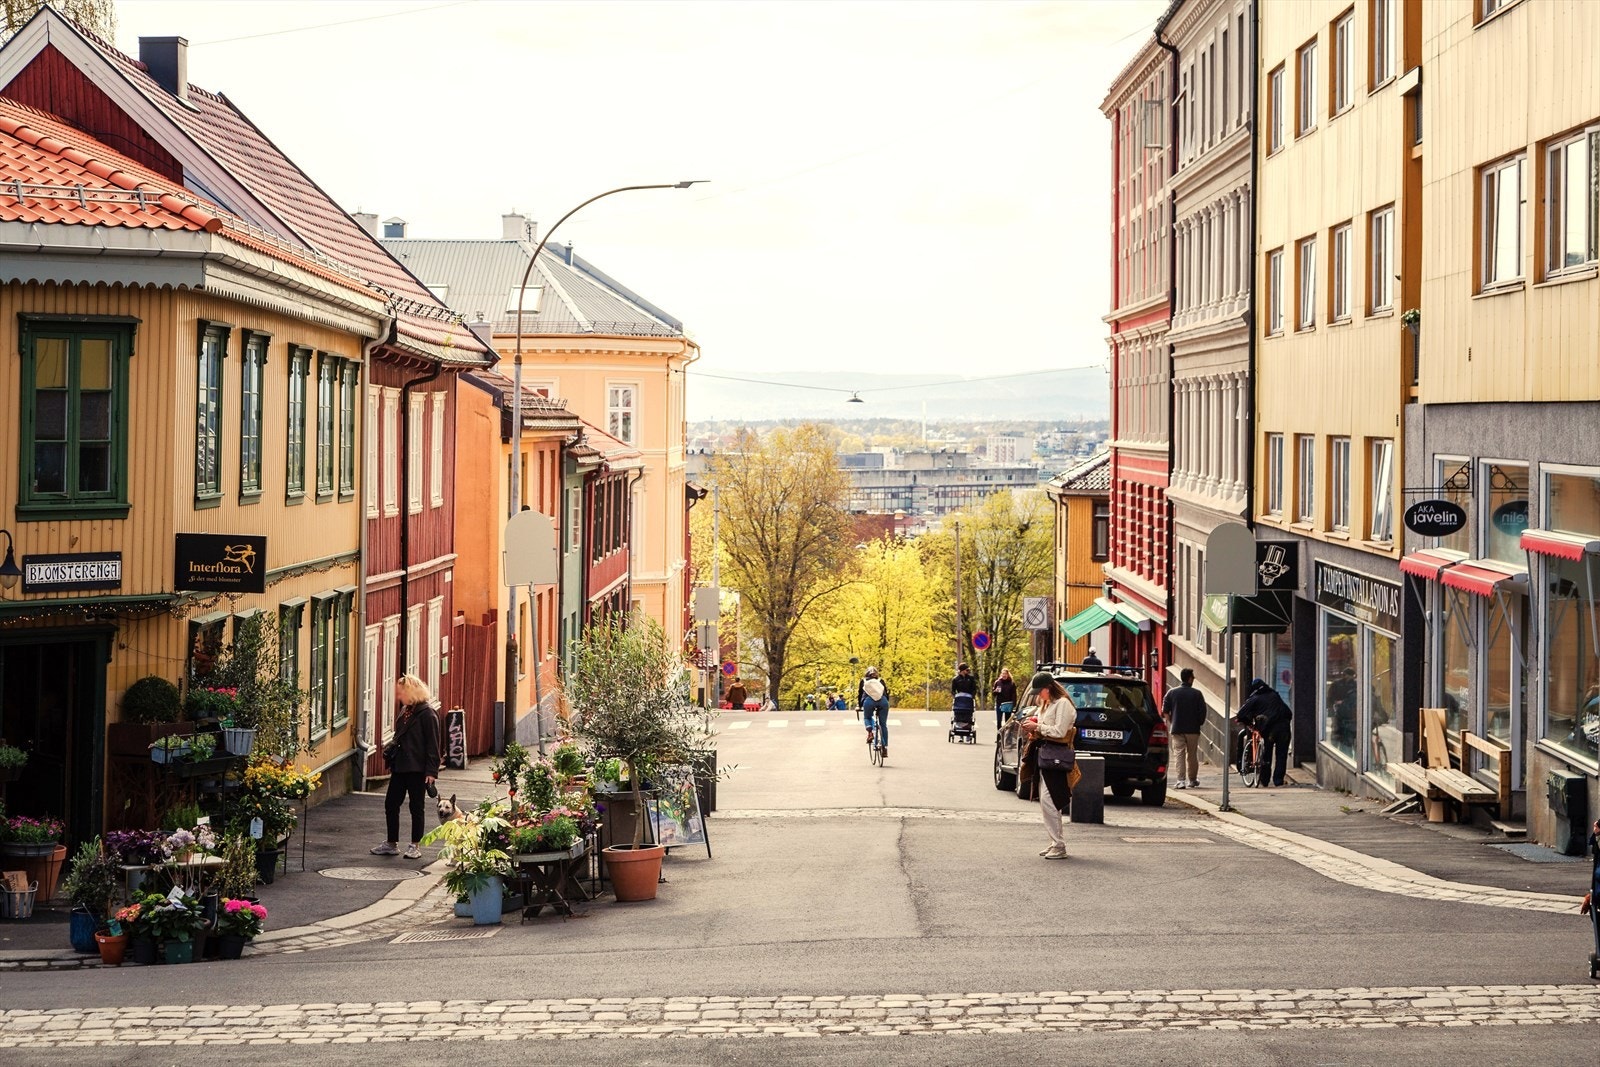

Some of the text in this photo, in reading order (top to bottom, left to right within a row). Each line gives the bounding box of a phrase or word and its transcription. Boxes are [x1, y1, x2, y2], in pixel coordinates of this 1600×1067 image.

[1417, 505, 1436, 514] AKA
[1413, 510, 1458, 525] javelin
[30, 563, 118, 581] BLOMSTERENGA
[189, 560, 241, 574] Interflora
[1323, 566, 1346, 598] KAMPEN
[1389, 588, 1399, 618] AS
[1087, 730, 1122, 739] BS 83429
